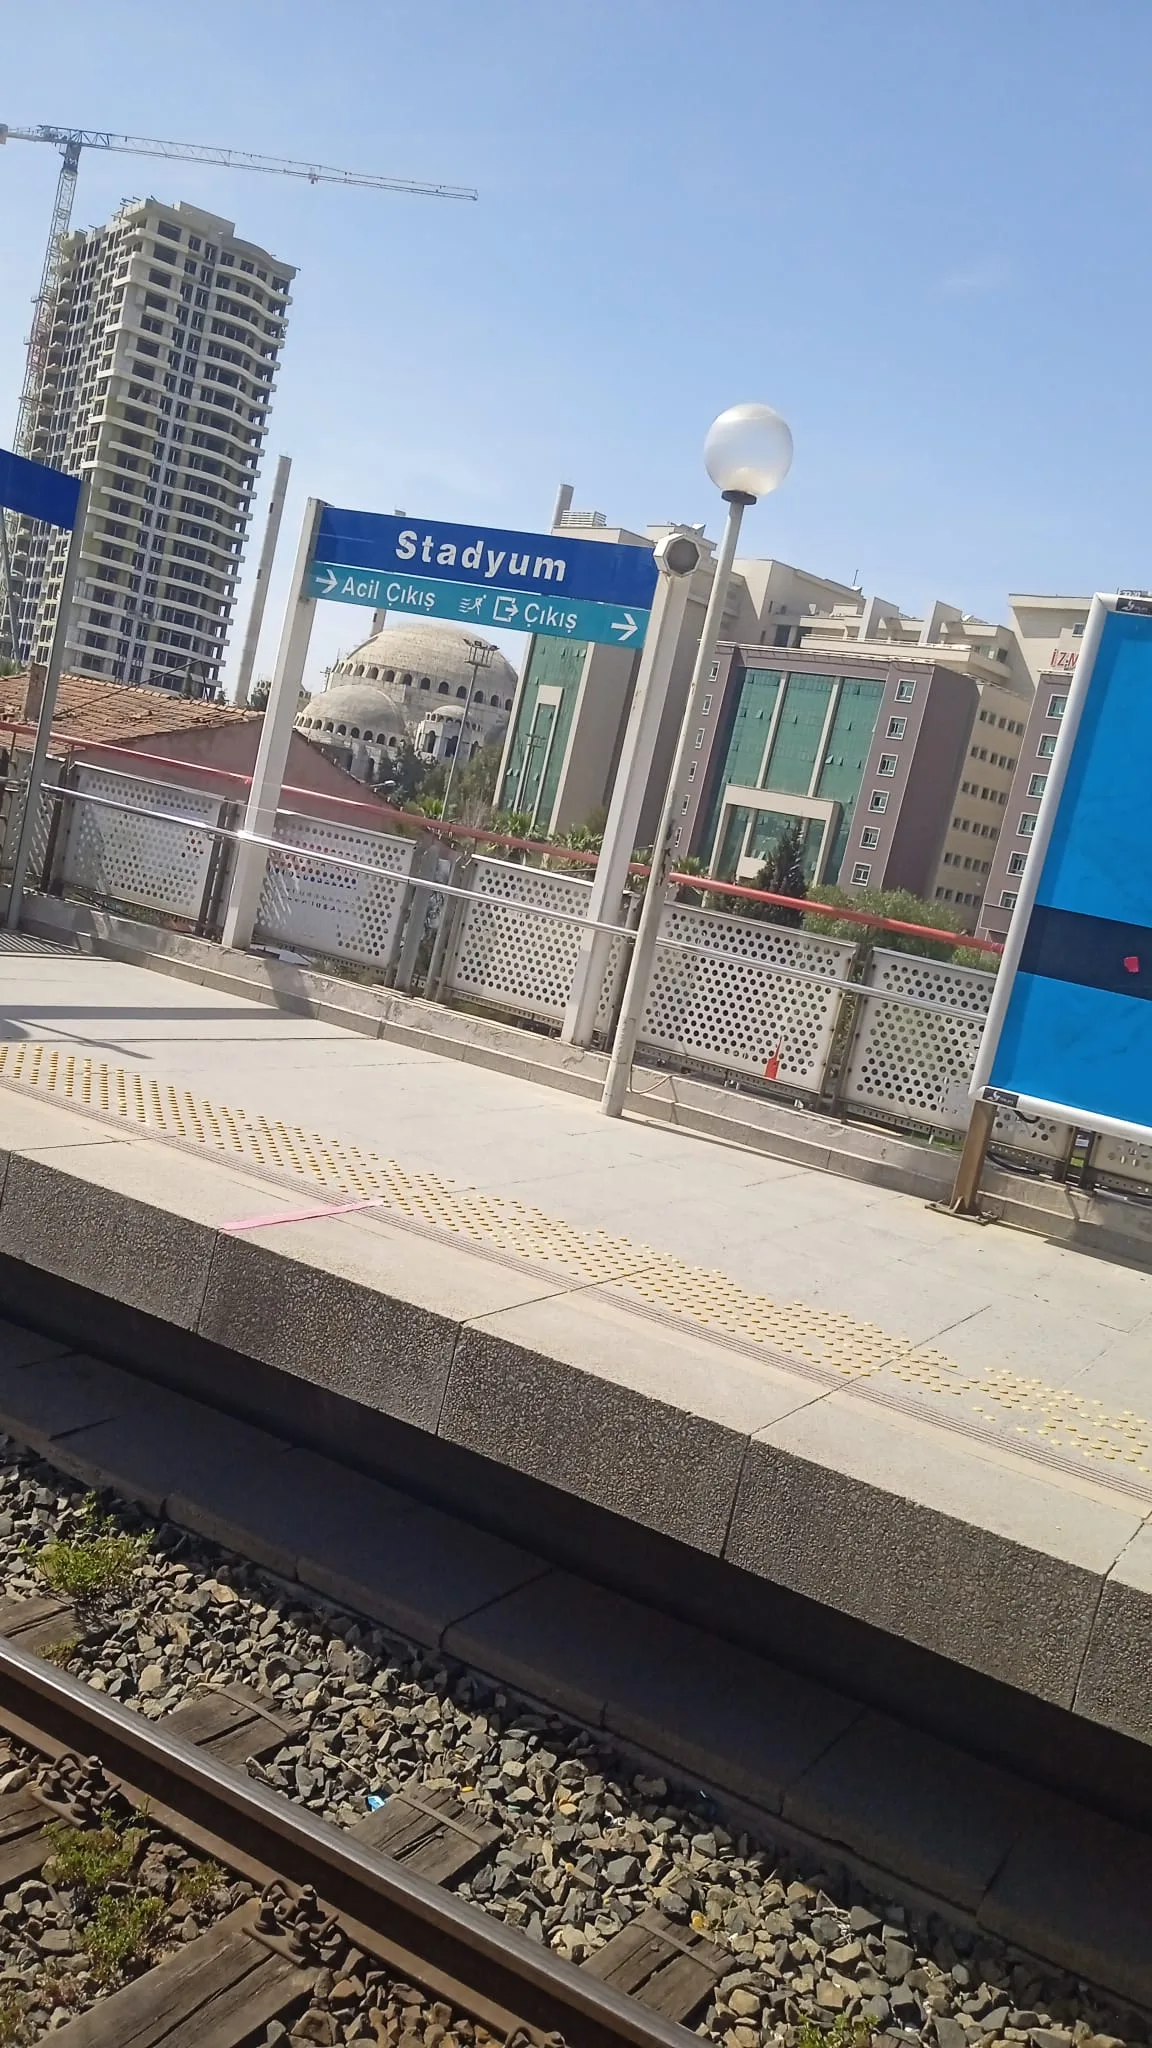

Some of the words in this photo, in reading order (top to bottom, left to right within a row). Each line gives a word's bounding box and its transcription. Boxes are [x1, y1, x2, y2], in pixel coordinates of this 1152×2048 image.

[395, 530, 567, 582] Stadyum
[341, 576, 380, 600] Acil
[386, 582, 436, 612] Çıkış
[524, 603, 578, 634] Çıkış
